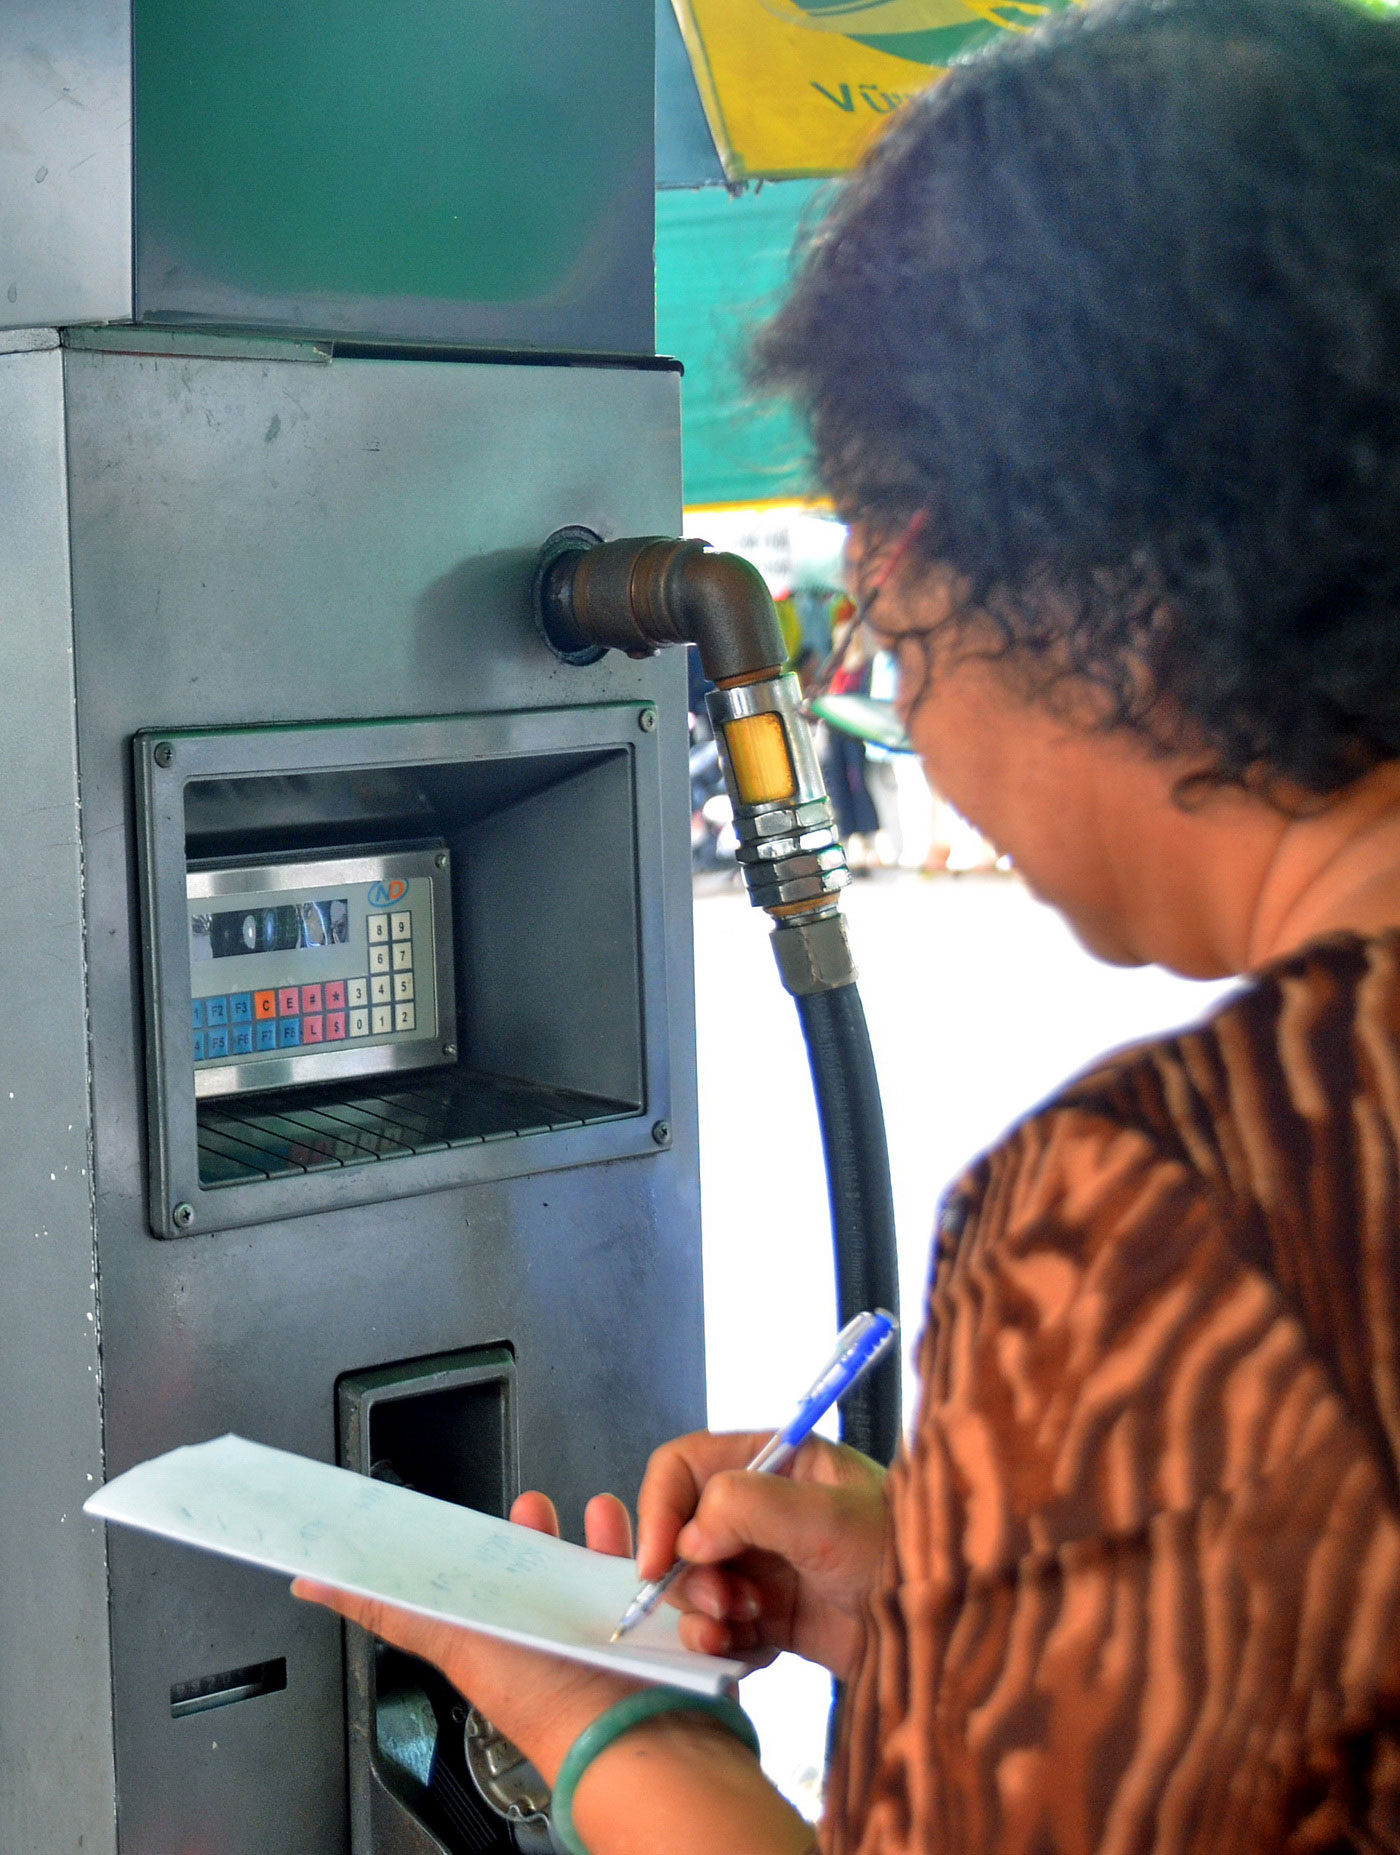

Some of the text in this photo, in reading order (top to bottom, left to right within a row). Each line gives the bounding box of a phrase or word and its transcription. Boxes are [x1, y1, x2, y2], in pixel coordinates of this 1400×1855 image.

[376, 921, 405, 936] 8 9
[377, 950, 406, 964] 6 7
[211, 1005, 224, 1017] F2
[235, 1002, 248, 1014] F3
[262, 1000, 270, 1012] C
[286, 997, 293, 1009] E
[356, 988, 362, 999] 3
[378, 983, 385, 995] 4
[401, 981, 407, 992] 5
[212, 1037, 225, 1049] F5
[262, 1029, 274, 1042] F7
[311, 1024, 317, 1036] L
[356, 1019, 363, 1030] 0
[380, 1015, 385, 1027] 1
[401, 1011, 408, 1023] 2
